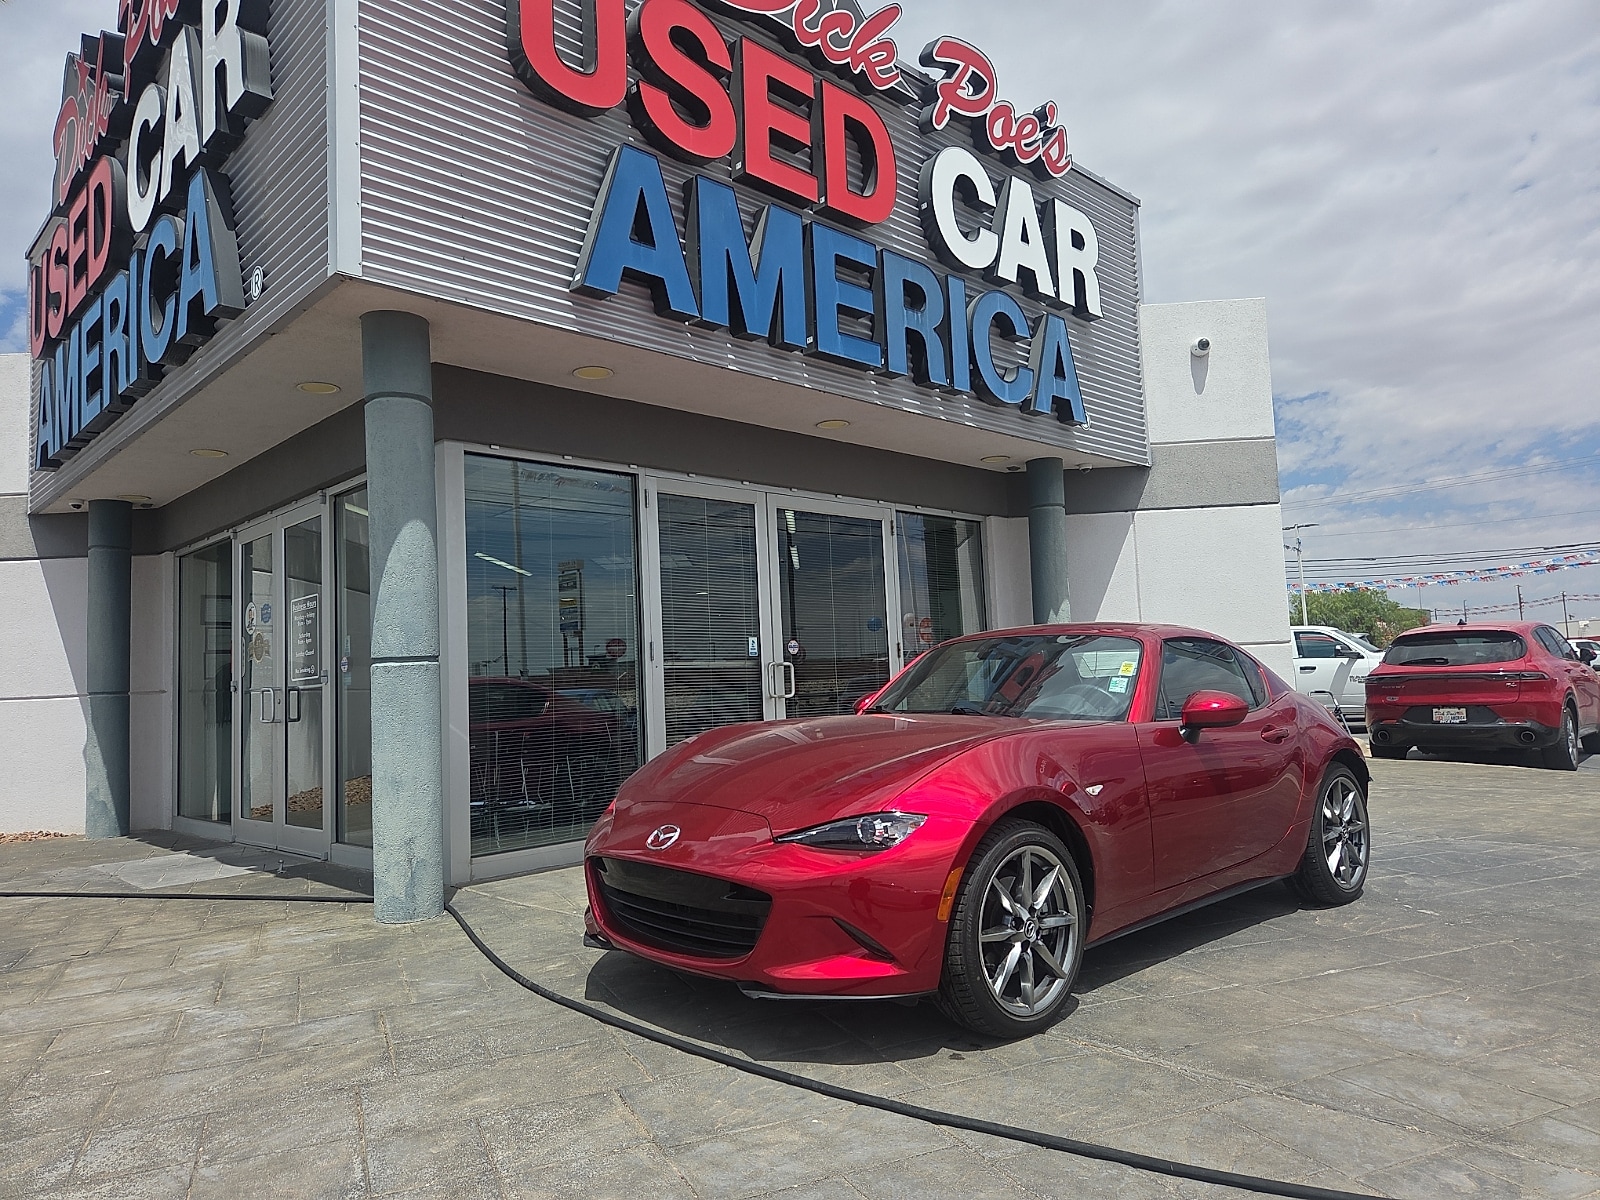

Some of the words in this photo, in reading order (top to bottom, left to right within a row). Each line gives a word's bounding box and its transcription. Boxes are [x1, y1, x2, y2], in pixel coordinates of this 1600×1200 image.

[30, 155, 116, 359] USED
[127, 0, 244, 232] CAR
[519, 0, 898, 224] USED
[930, 146, 1104, 319] CAR
[720, 0, 902, 90] ick
[931, 36, 1073, 179] Poe's
[36, 167, 218, 471] AMERICA
[583, 143, 1089, 426] AMERICA
